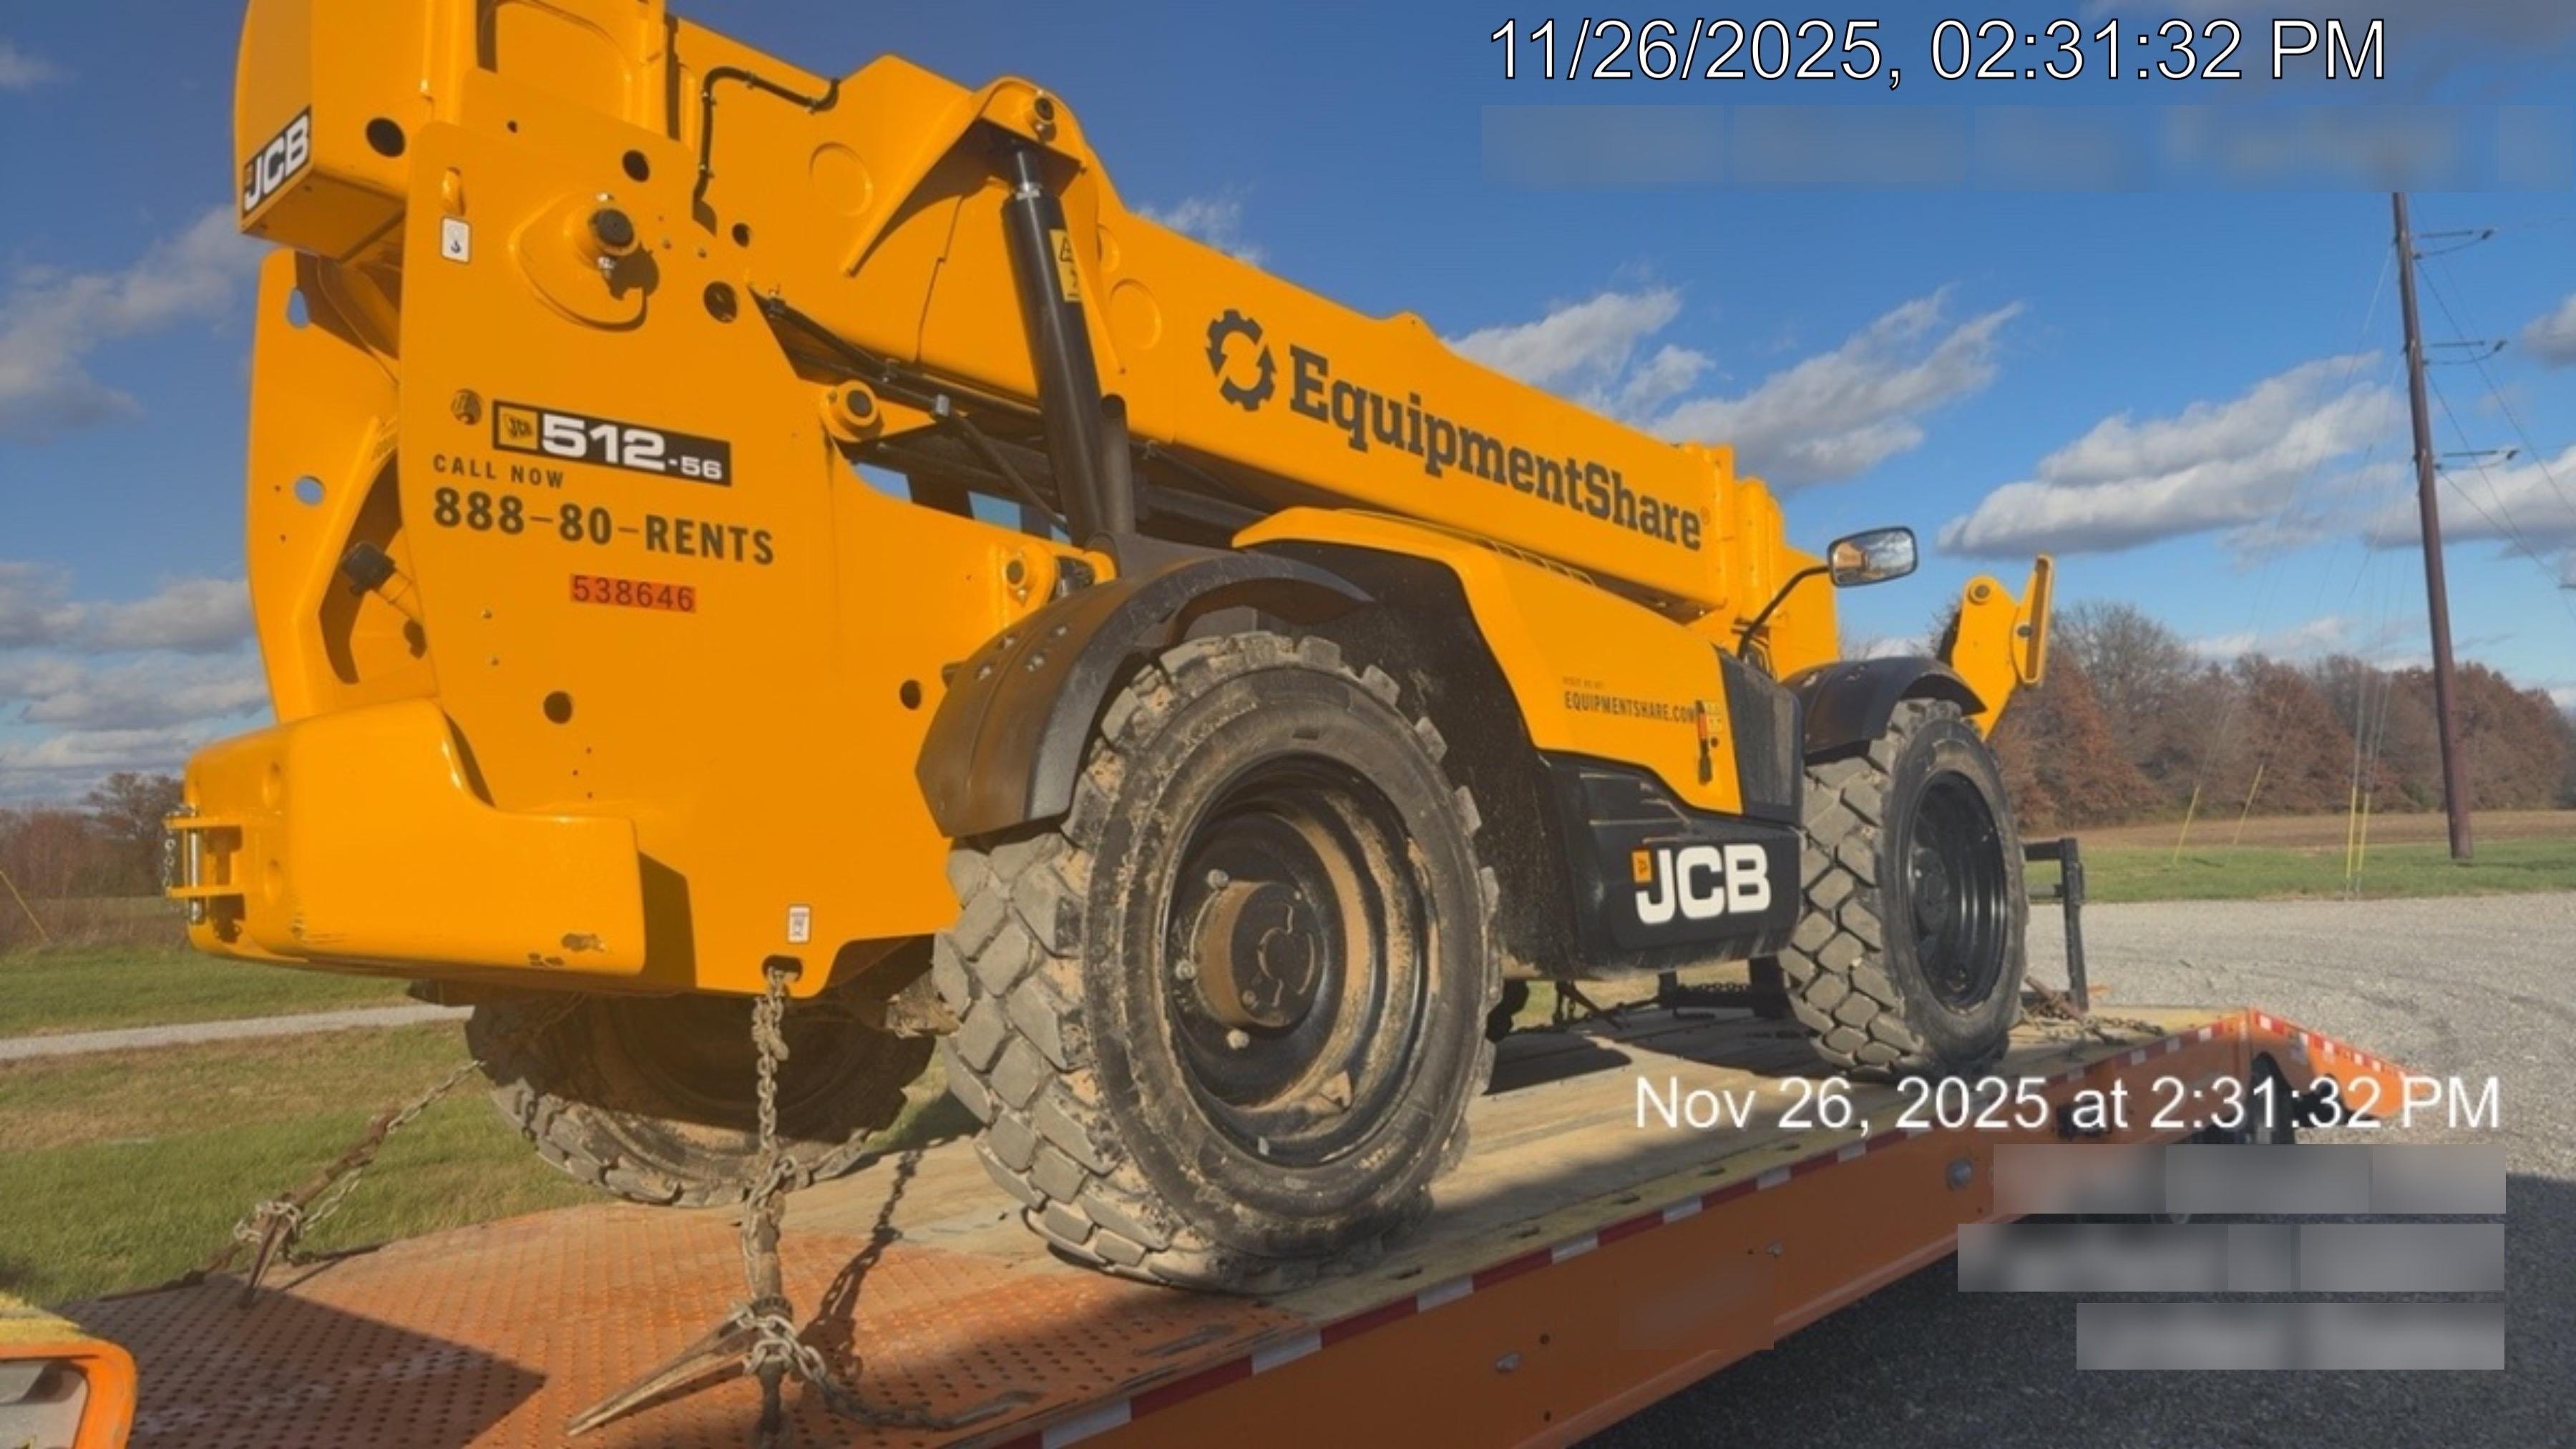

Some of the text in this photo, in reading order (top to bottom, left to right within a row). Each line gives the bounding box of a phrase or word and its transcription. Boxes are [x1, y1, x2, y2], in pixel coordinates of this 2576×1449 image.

[244, 113, 309, 213] JCB
[432, 454, 565, 489] CALL NOW
[1289, 344, 1702, 552] EquipmentShare
[433, 486, 774, 566] 888-80-RENTS
[572, 574, 696, 613] 538646
[1635, 844, 1772, 924] JCB
